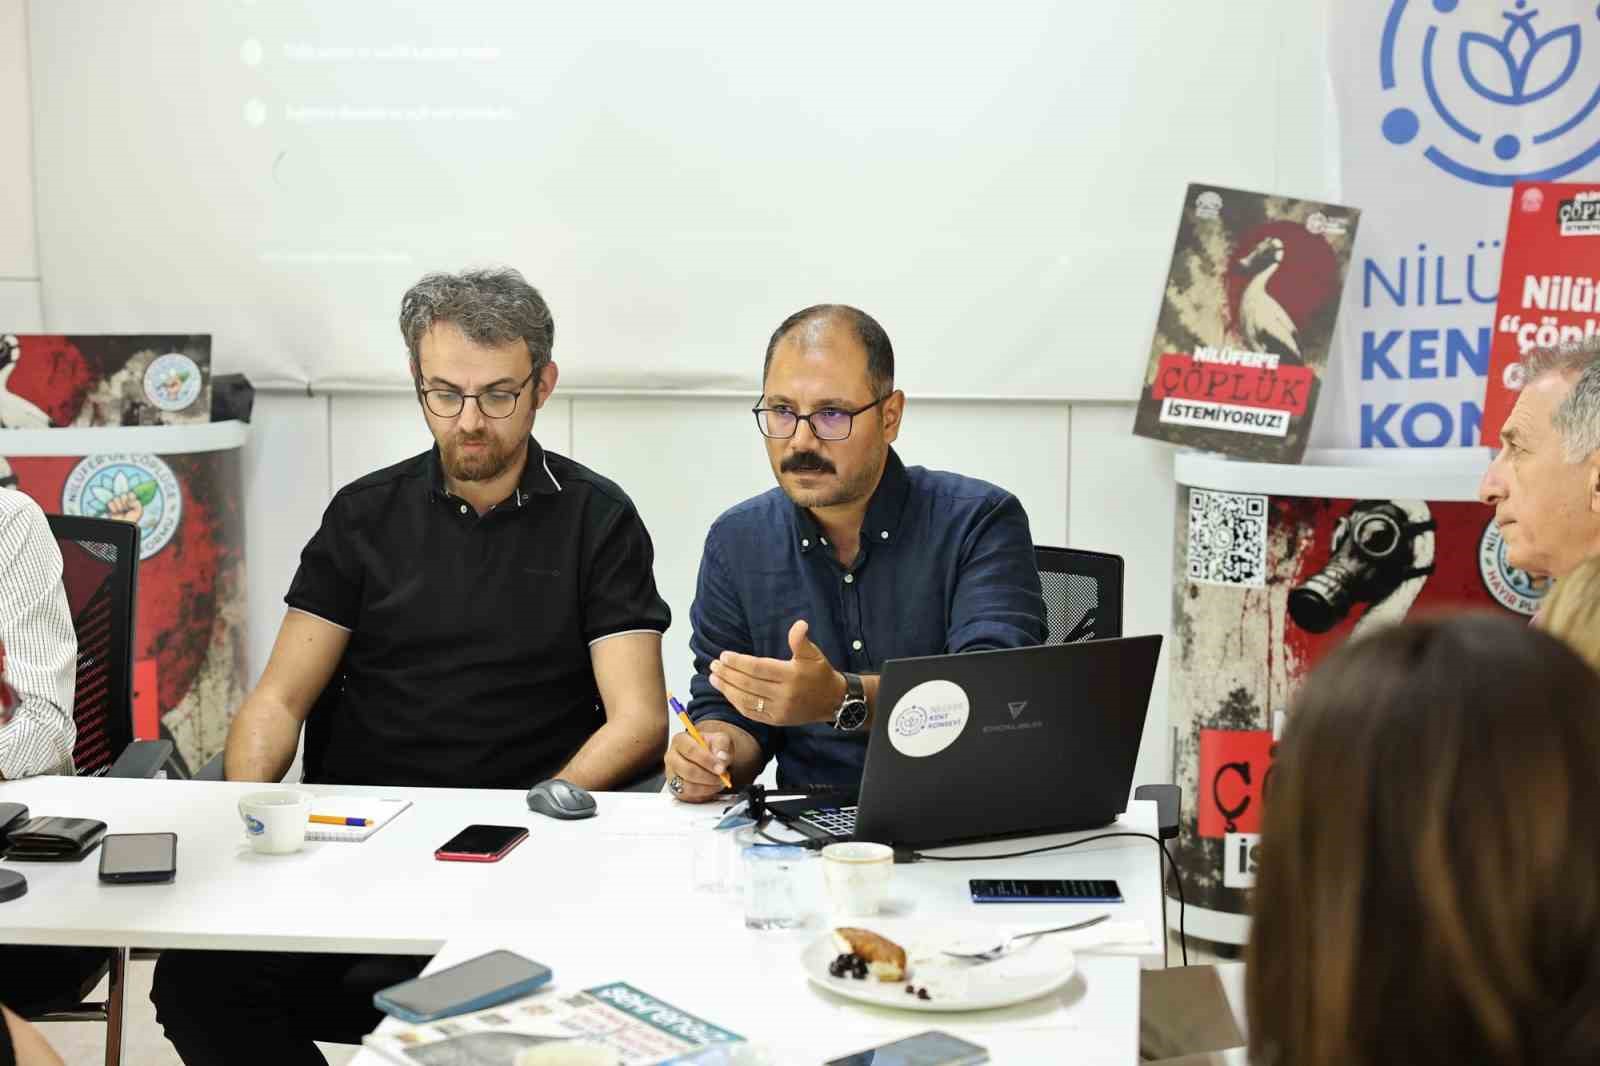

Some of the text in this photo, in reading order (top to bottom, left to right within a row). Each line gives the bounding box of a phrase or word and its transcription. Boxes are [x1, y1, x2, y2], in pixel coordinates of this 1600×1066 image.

[1363, 242, 1500, 308] NİLÜ
[1361, 327, 1491, 381] KEN
[1161, 362, 1305, 407] ÇÖPLÜK
[1167, 401, 1283, 429] İSTEMİYORUZ!
